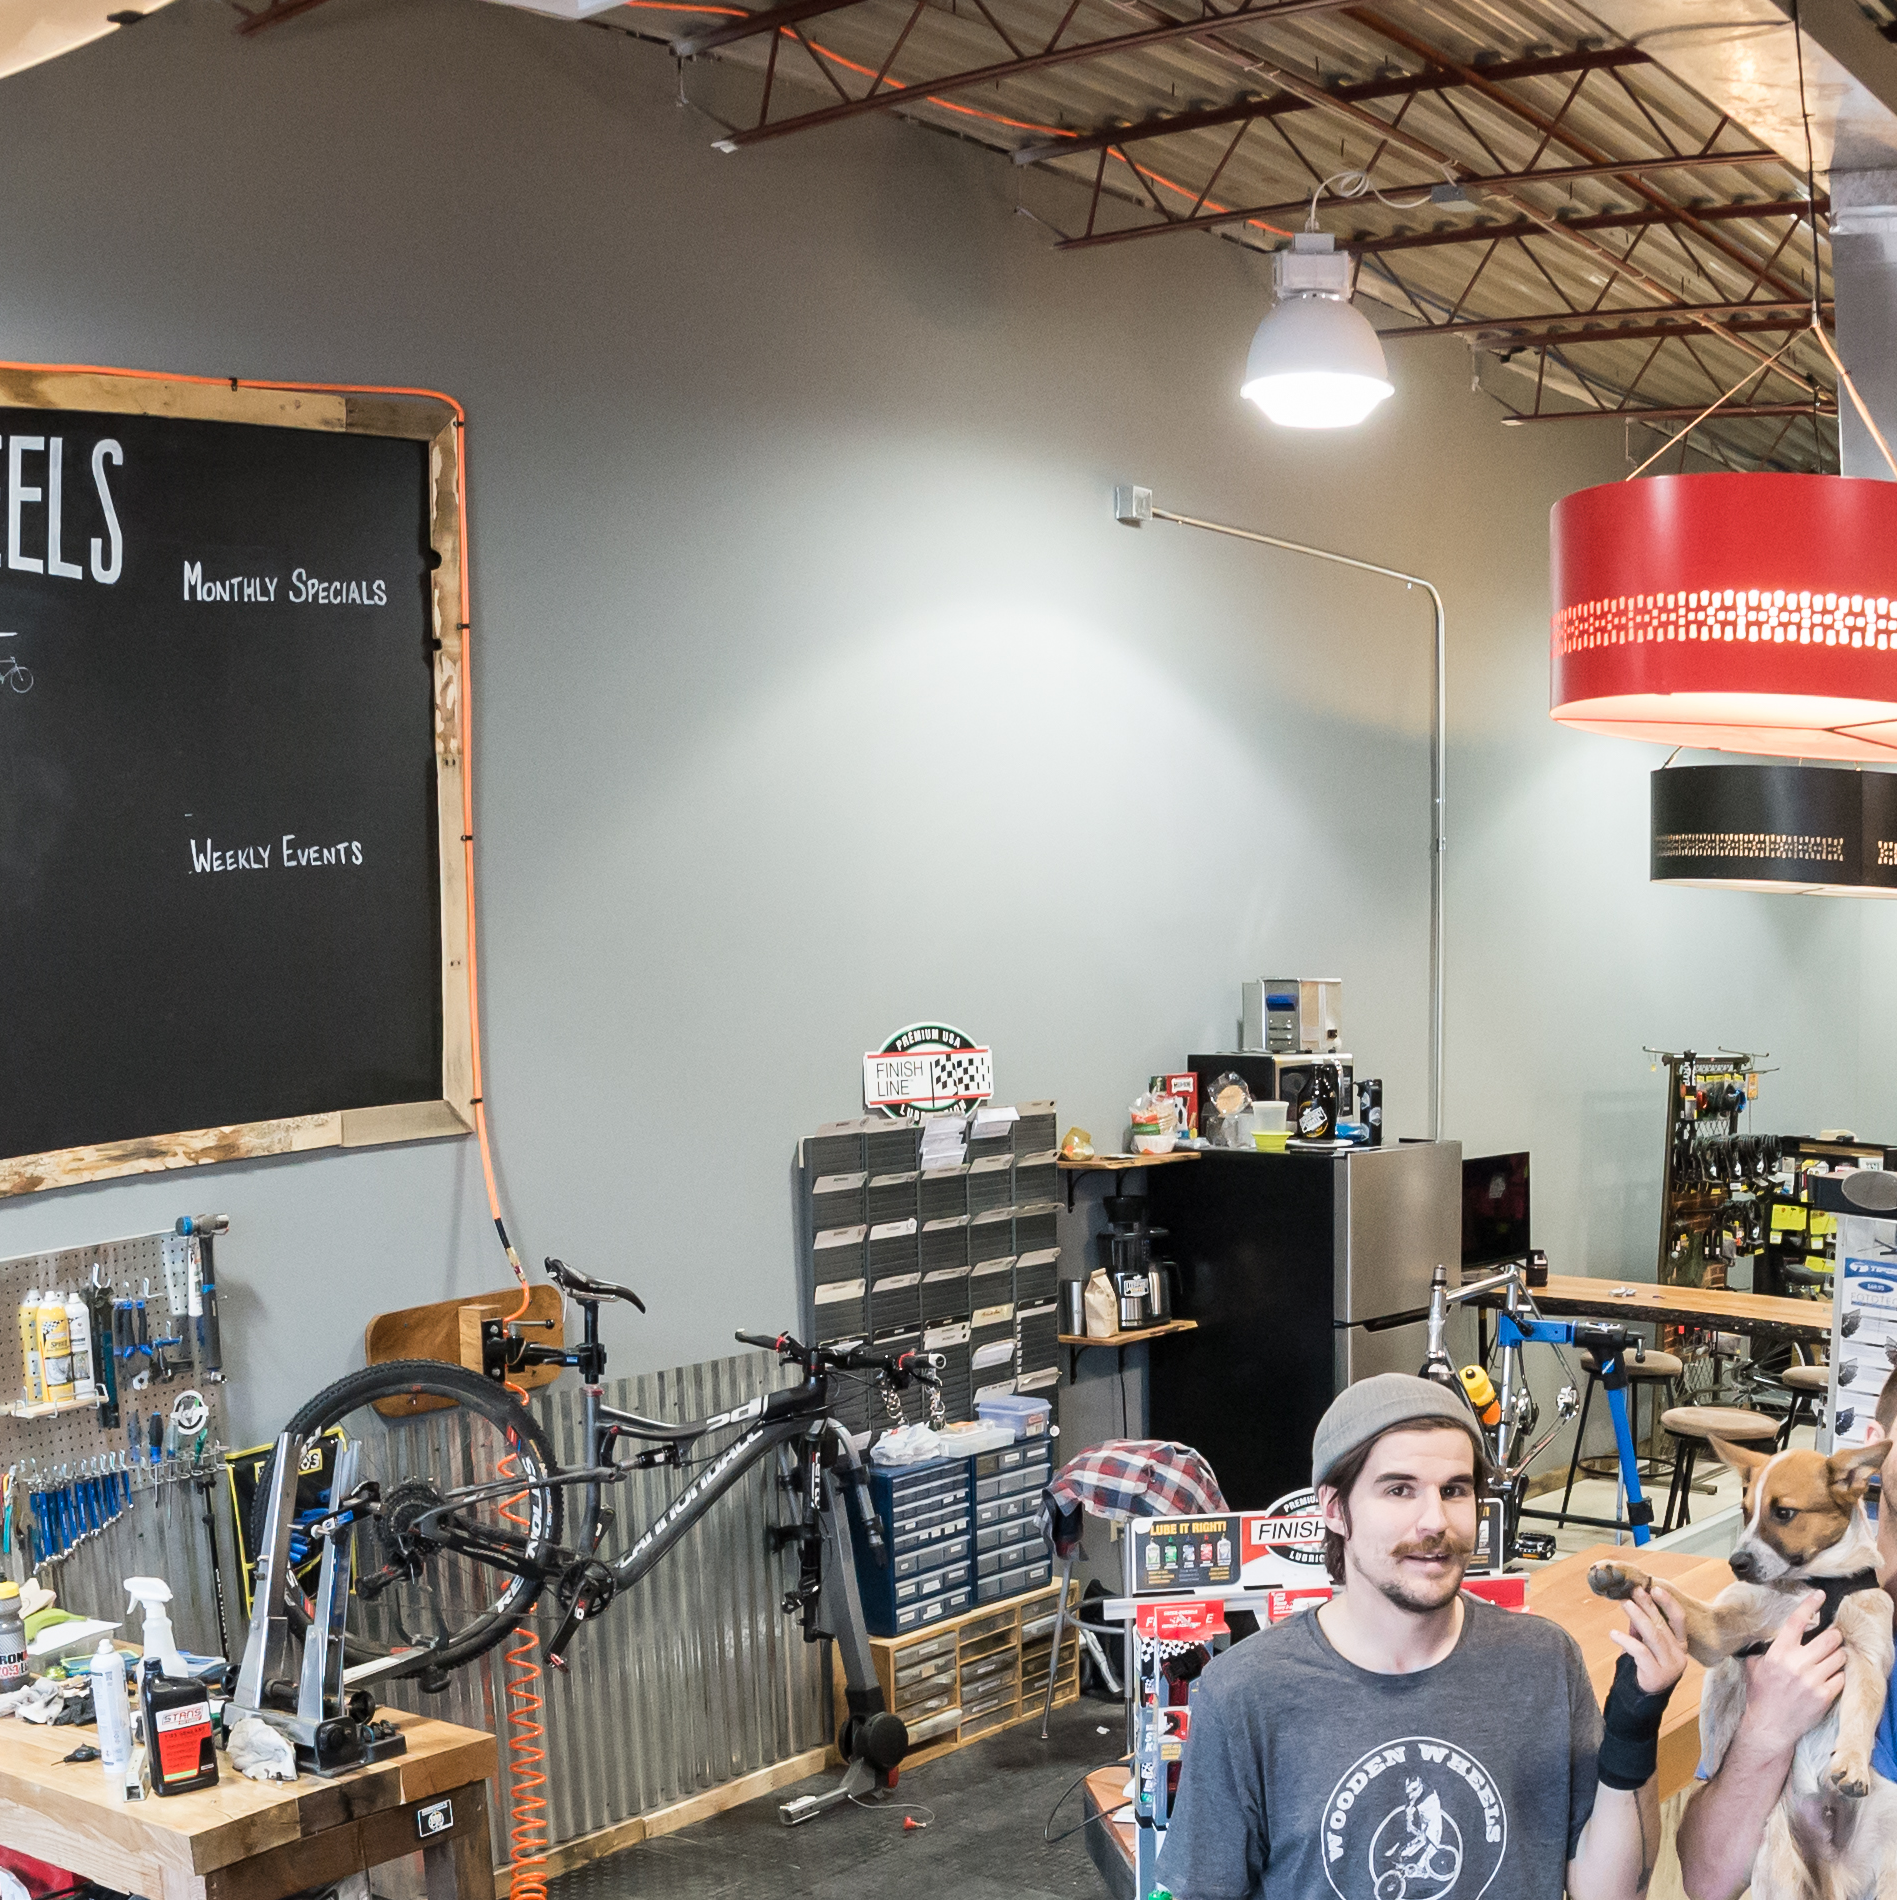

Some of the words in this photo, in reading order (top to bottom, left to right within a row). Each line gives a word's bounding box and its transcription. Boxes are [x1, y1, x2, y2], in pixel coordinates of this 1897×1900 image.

[183, 560, 277, 603] MONTHLY
[289, 567, 388, 606] SPECIALS
[189, 837, 271, 873] WEEKLY
[282, 834, 363, 868] EVENTS
[896, 1028, 939, 1051] PREMIUM
[942, 1030, 961, 1049] USA
[876, 1060, 923, 1079] FINISH
[877, 1079, 910, 1097] LINE
[1150, 1522, 1177, 1536] LUBE
[1179, 1522, 1190, 1535] IT
[1192, 1520, 1227, 1534] RIGHT!
[1258, 1520, 1325, 1541] FINISH
[1327, 1746, 1406, 1863] WOODEN
[1418, 1743, 1502, 1844] WHEELS
